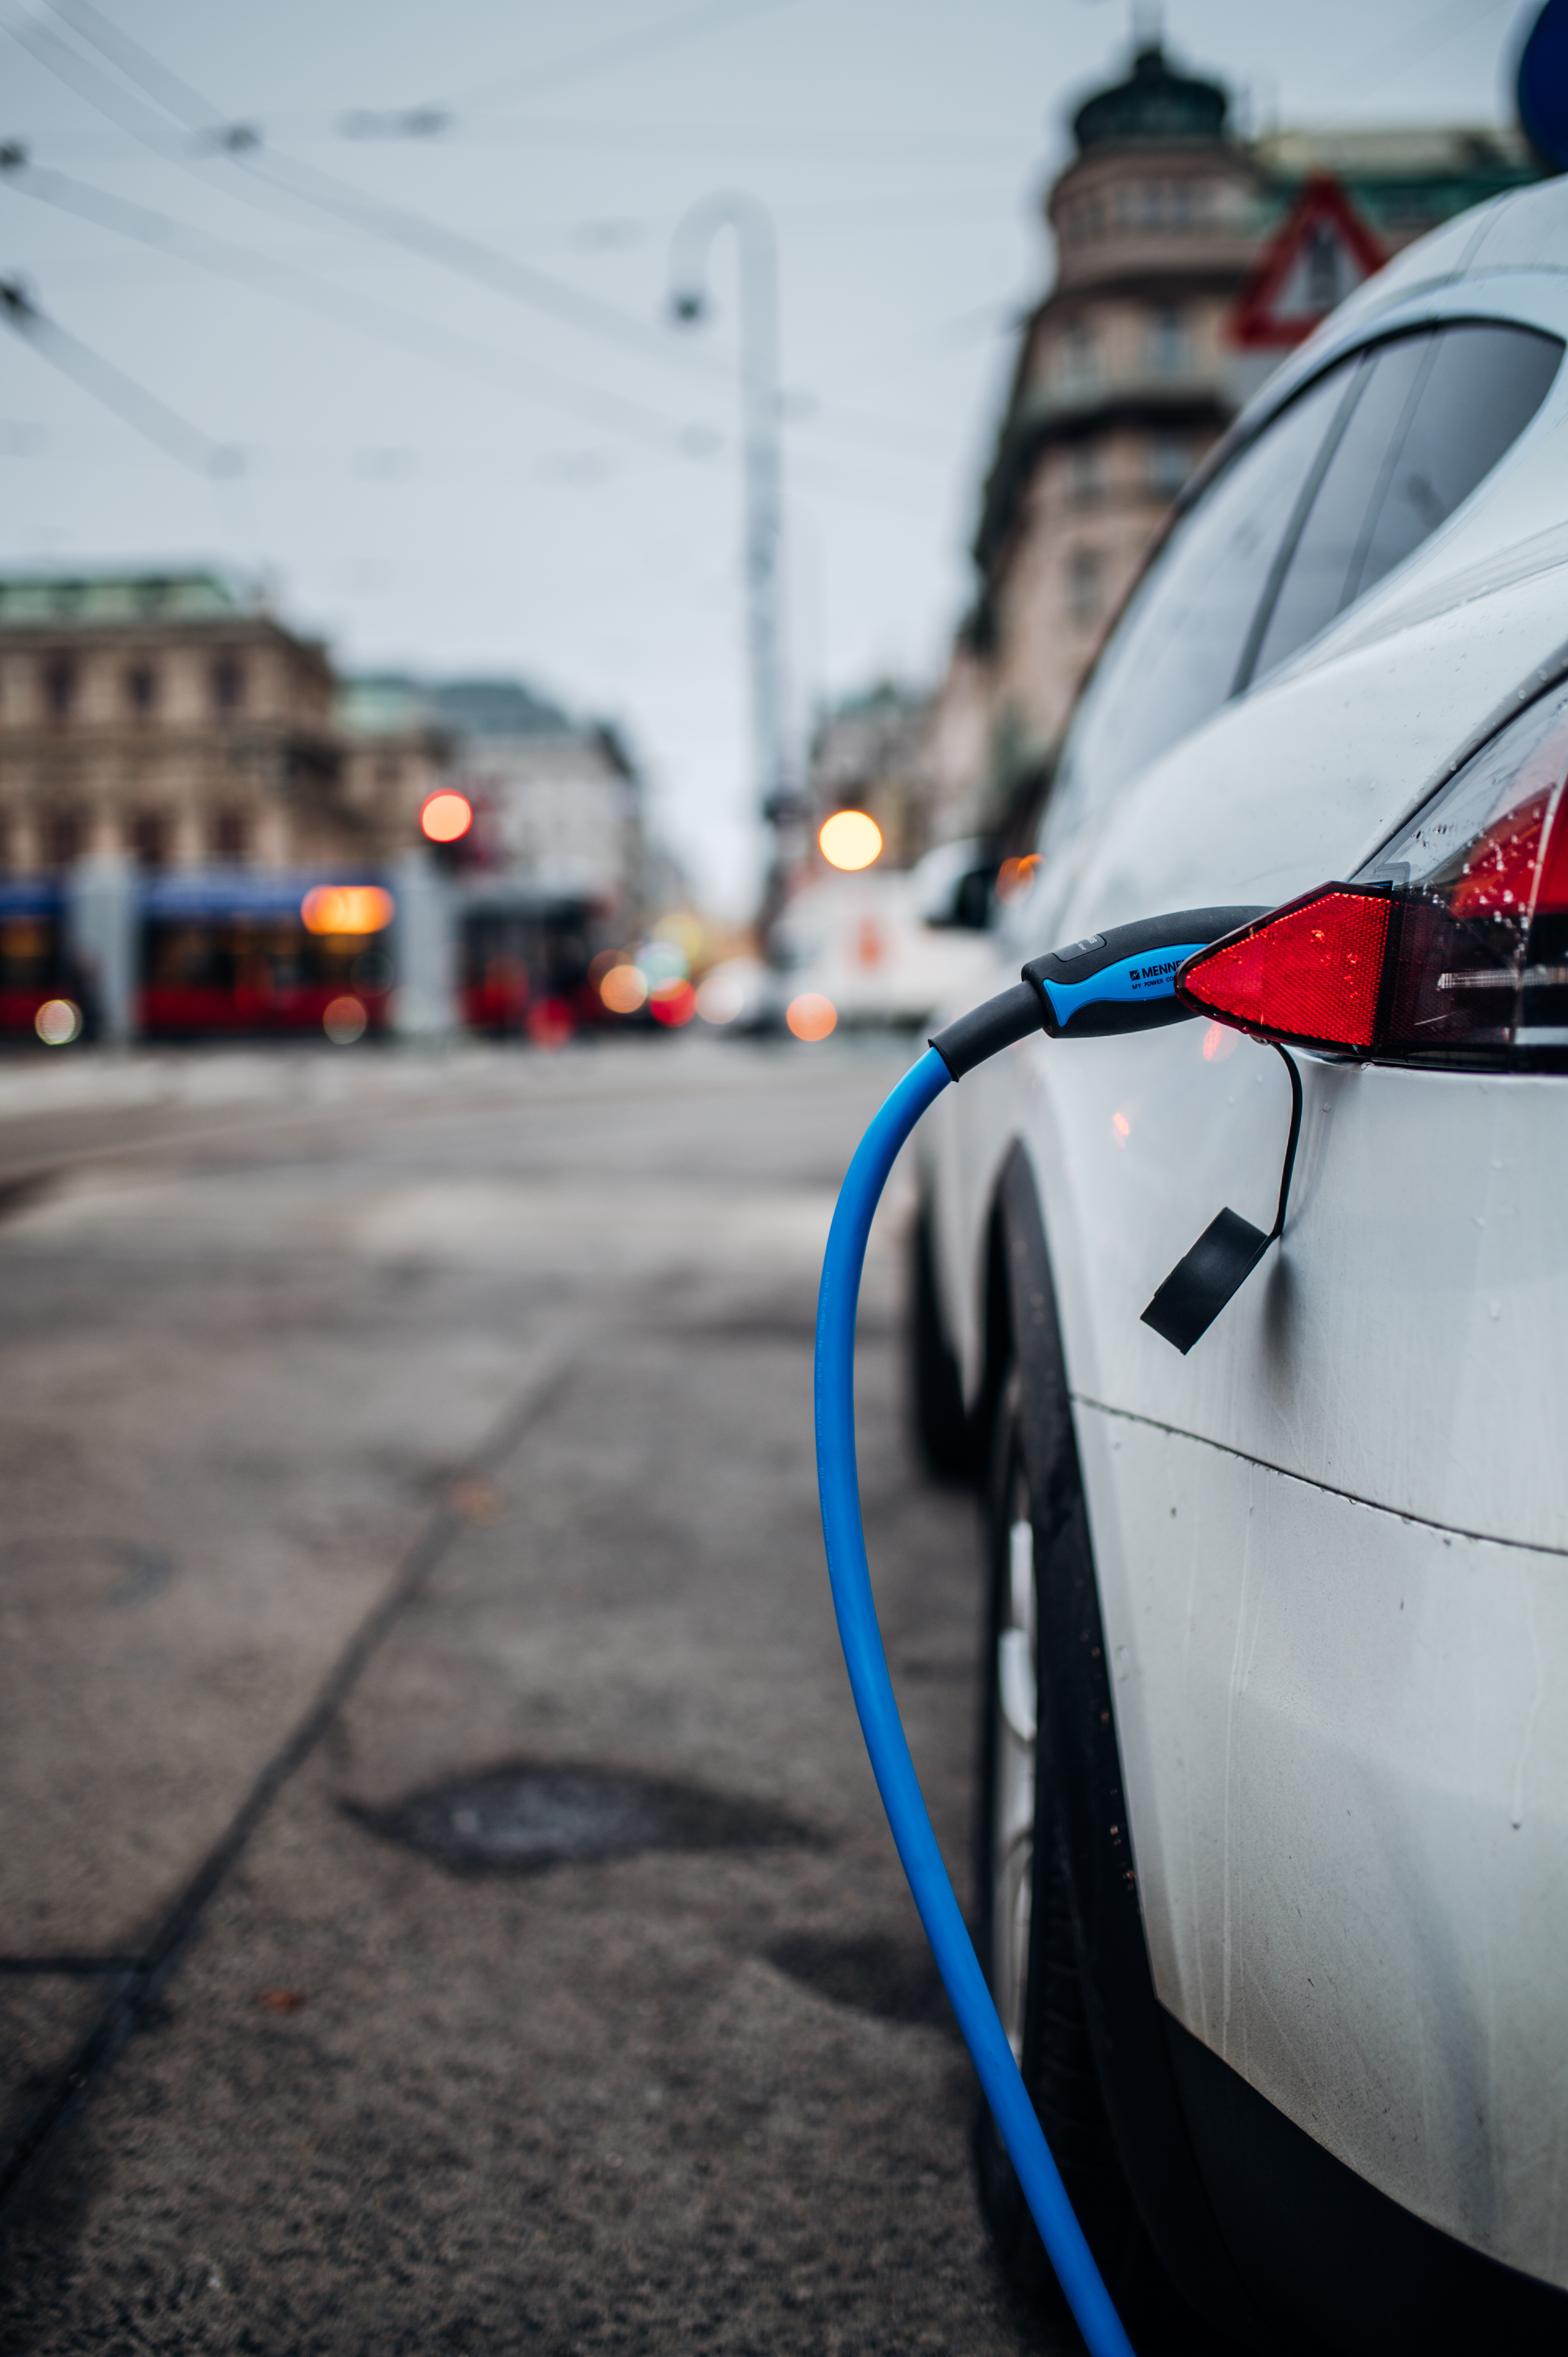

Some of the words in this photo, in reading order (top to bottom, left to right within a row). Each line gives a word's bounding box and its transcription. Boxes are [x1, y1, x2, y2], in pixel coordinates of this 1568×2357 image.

[1142, 959, 1184, 978] MENNE
[1144, 979, 1164, 987] POWER
[822, 1499, 830, 1541] CHARGING
